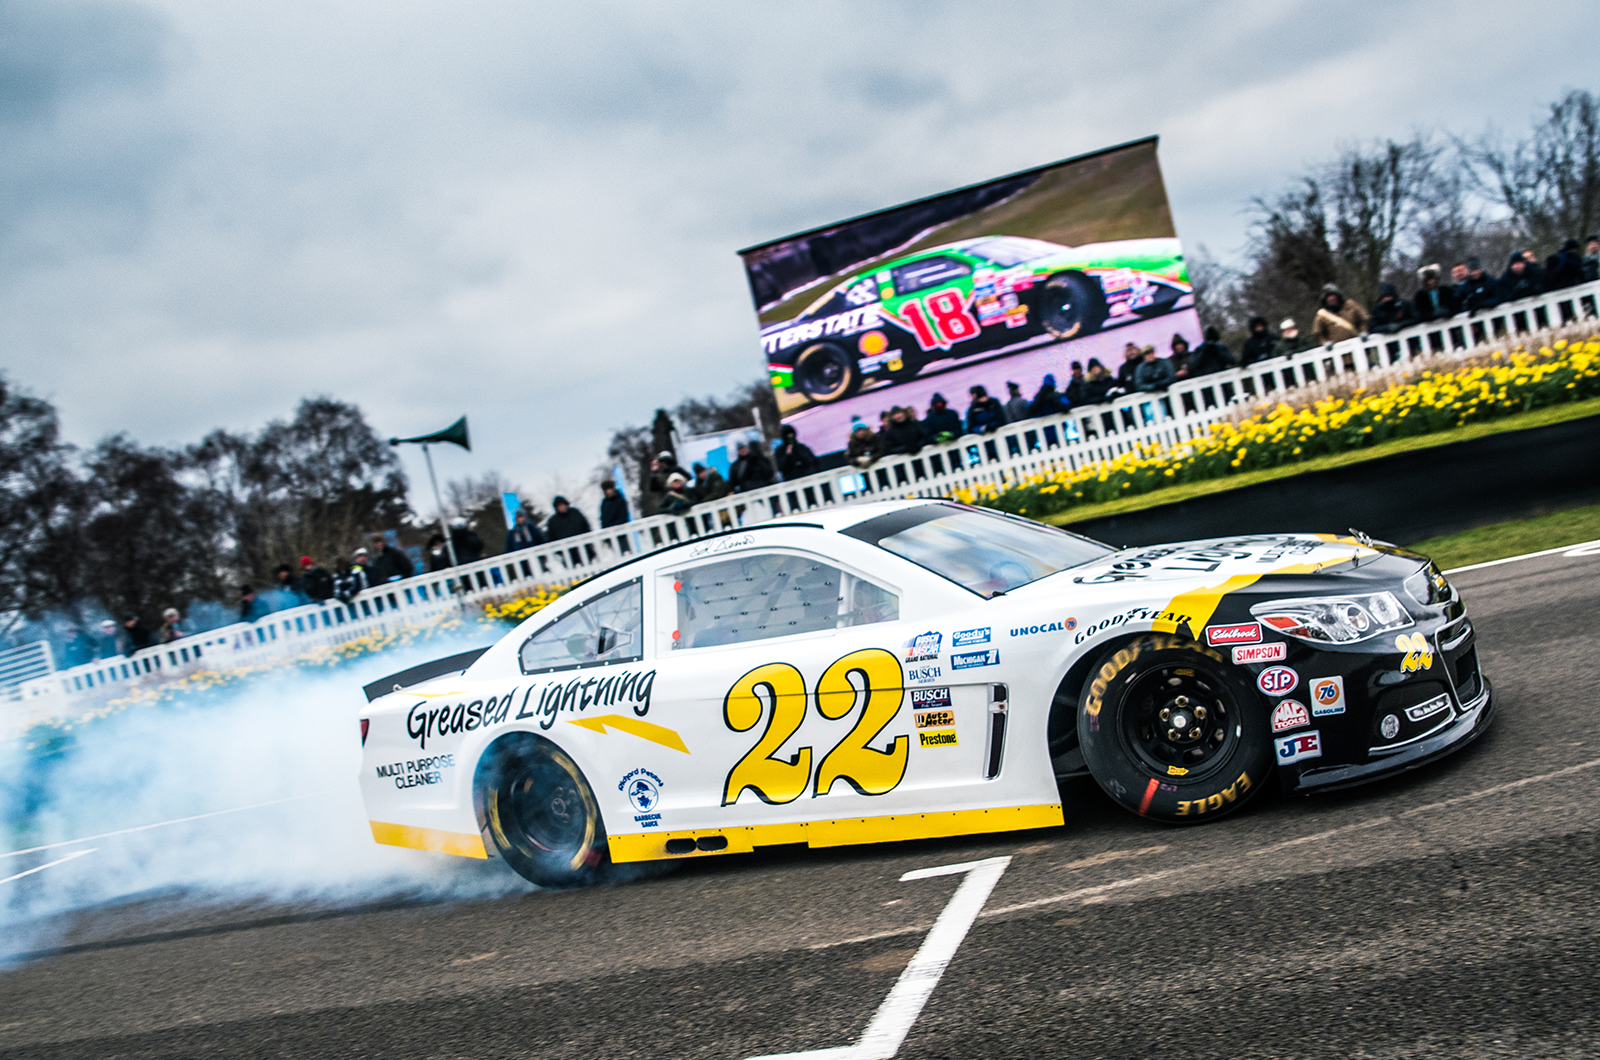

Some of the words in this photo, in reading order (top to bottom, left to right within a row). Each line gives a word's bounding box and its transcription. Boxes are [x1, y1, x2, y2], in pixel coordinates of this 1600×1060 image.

[898, 287, 980, 350] 18
[1010, 622, 1064, 637] UNOCAL
[1074, 606, 1192, 645] GOODYEAR
[1211, 628, 1258, 640] Edelbrock
[953, 628, 991, 641] Goody's
[1236, 645, 1281, 661] SIMPSON
[1395, 631, 1433, 673] 22
[953, 655, 985, 667] MICHIGAN
[909, 667, 941, 681] BUSCH
[1263, 669, 1292, 690] STP
[913, 688, 949, 702] BUSCH
[1317, 684, 1337, 701] 76
[407, 686, 519, 750] Greased
[516, 669, 656, 730] Lightning
[927, 712, 948, 720] Auto
[1275, 702, 1306, 722] MAC
[1314, 707, 1345, 715] GASOLINE
[720, 647, 910, 807] 22
[926, 718, 953, 726] Meter
[1276, 717, 1307, 729] TOOLS
[919, 733, 957, 746] Prestone
[1279, 735, 1318, 757] JE
[376, 762, 404, 778] MULTI
[406, 754, 455, 773] PURPOSE
[395, 771, 443, 790] CLEANER
[617, 768, 640, 791] Richard
[1174, 771, 1252, 816] EAGLE
